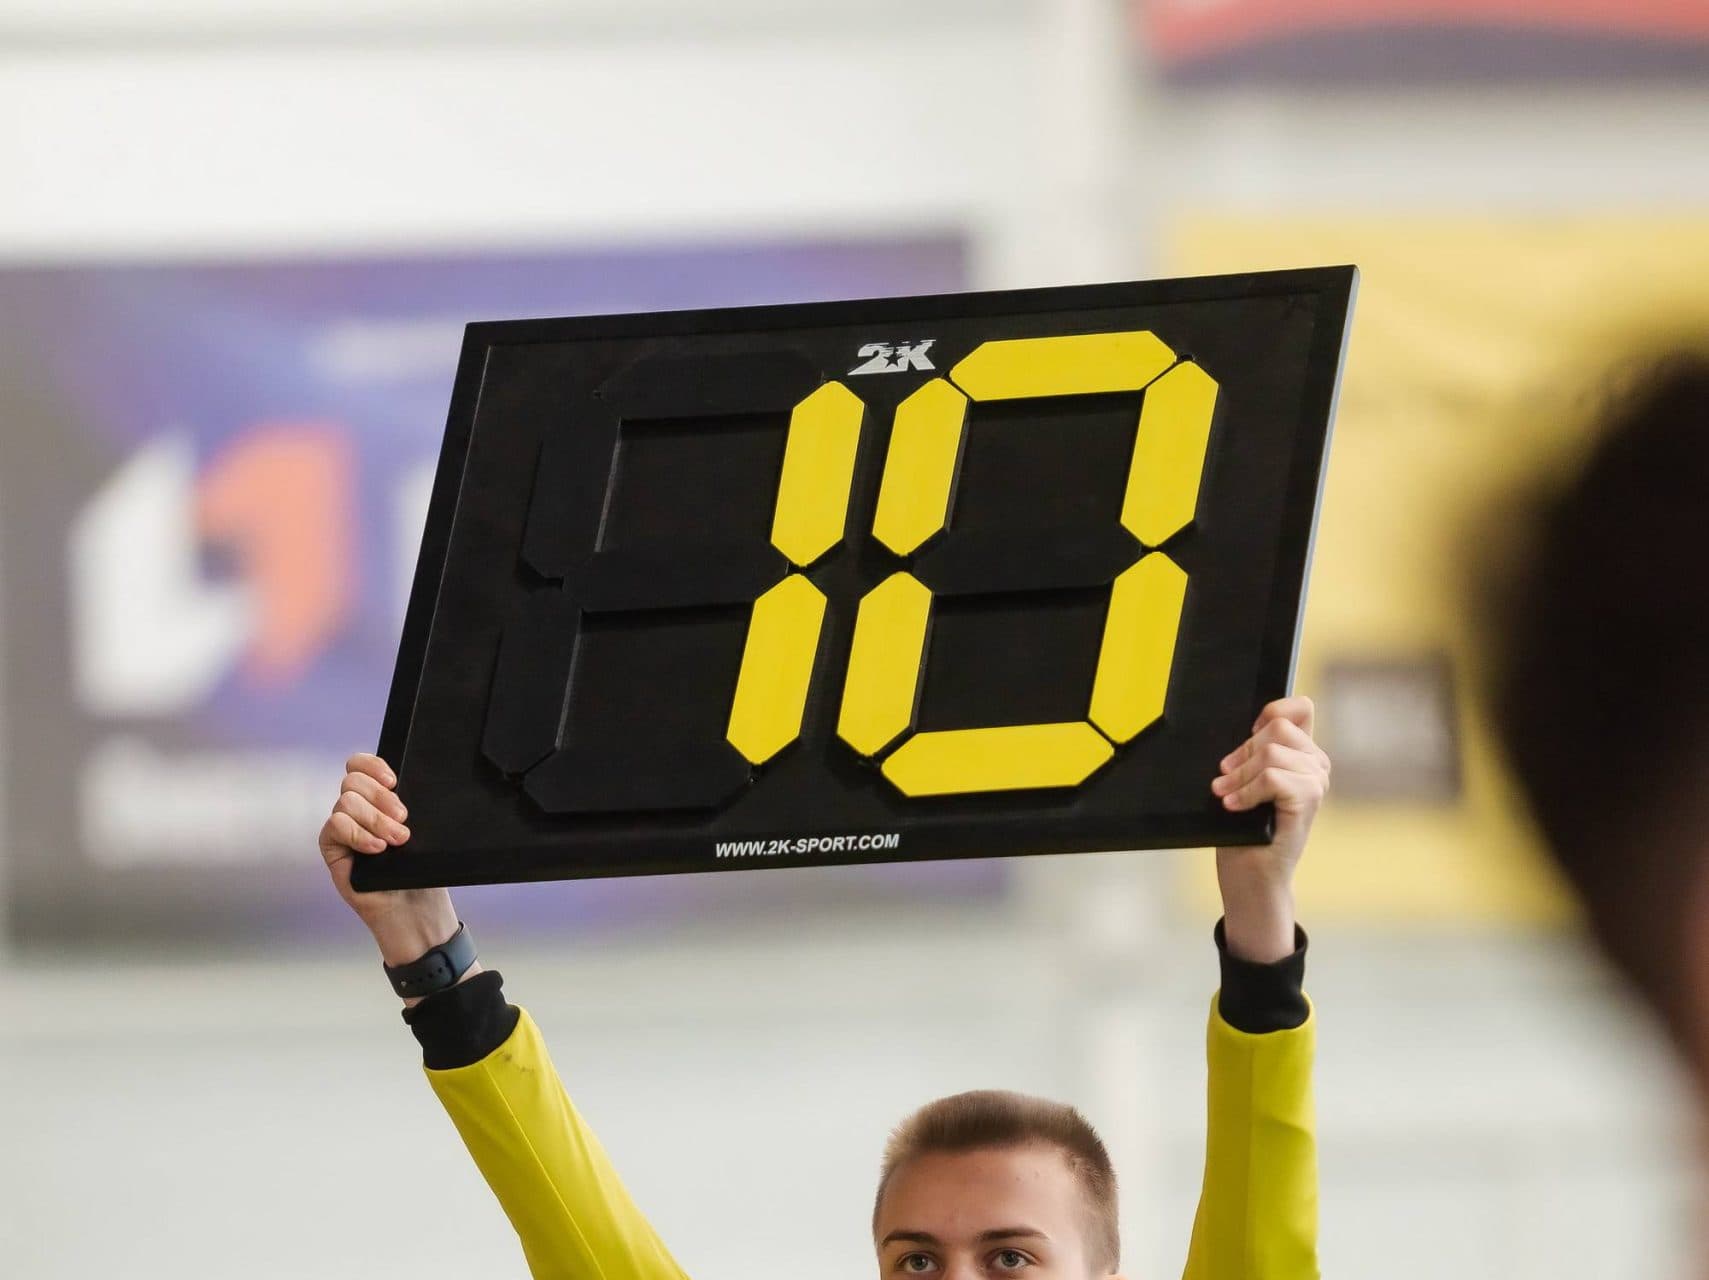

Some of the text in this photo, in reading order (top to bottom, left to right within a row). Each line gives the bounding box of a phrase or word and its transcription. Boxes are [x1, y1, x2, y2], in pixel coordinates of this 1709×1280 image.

[847, 339, 937, 376] 2K
[725, 330, 1220, 798] 10
[715, 833, 901, 858] WWW.2K-SPORT.COM
